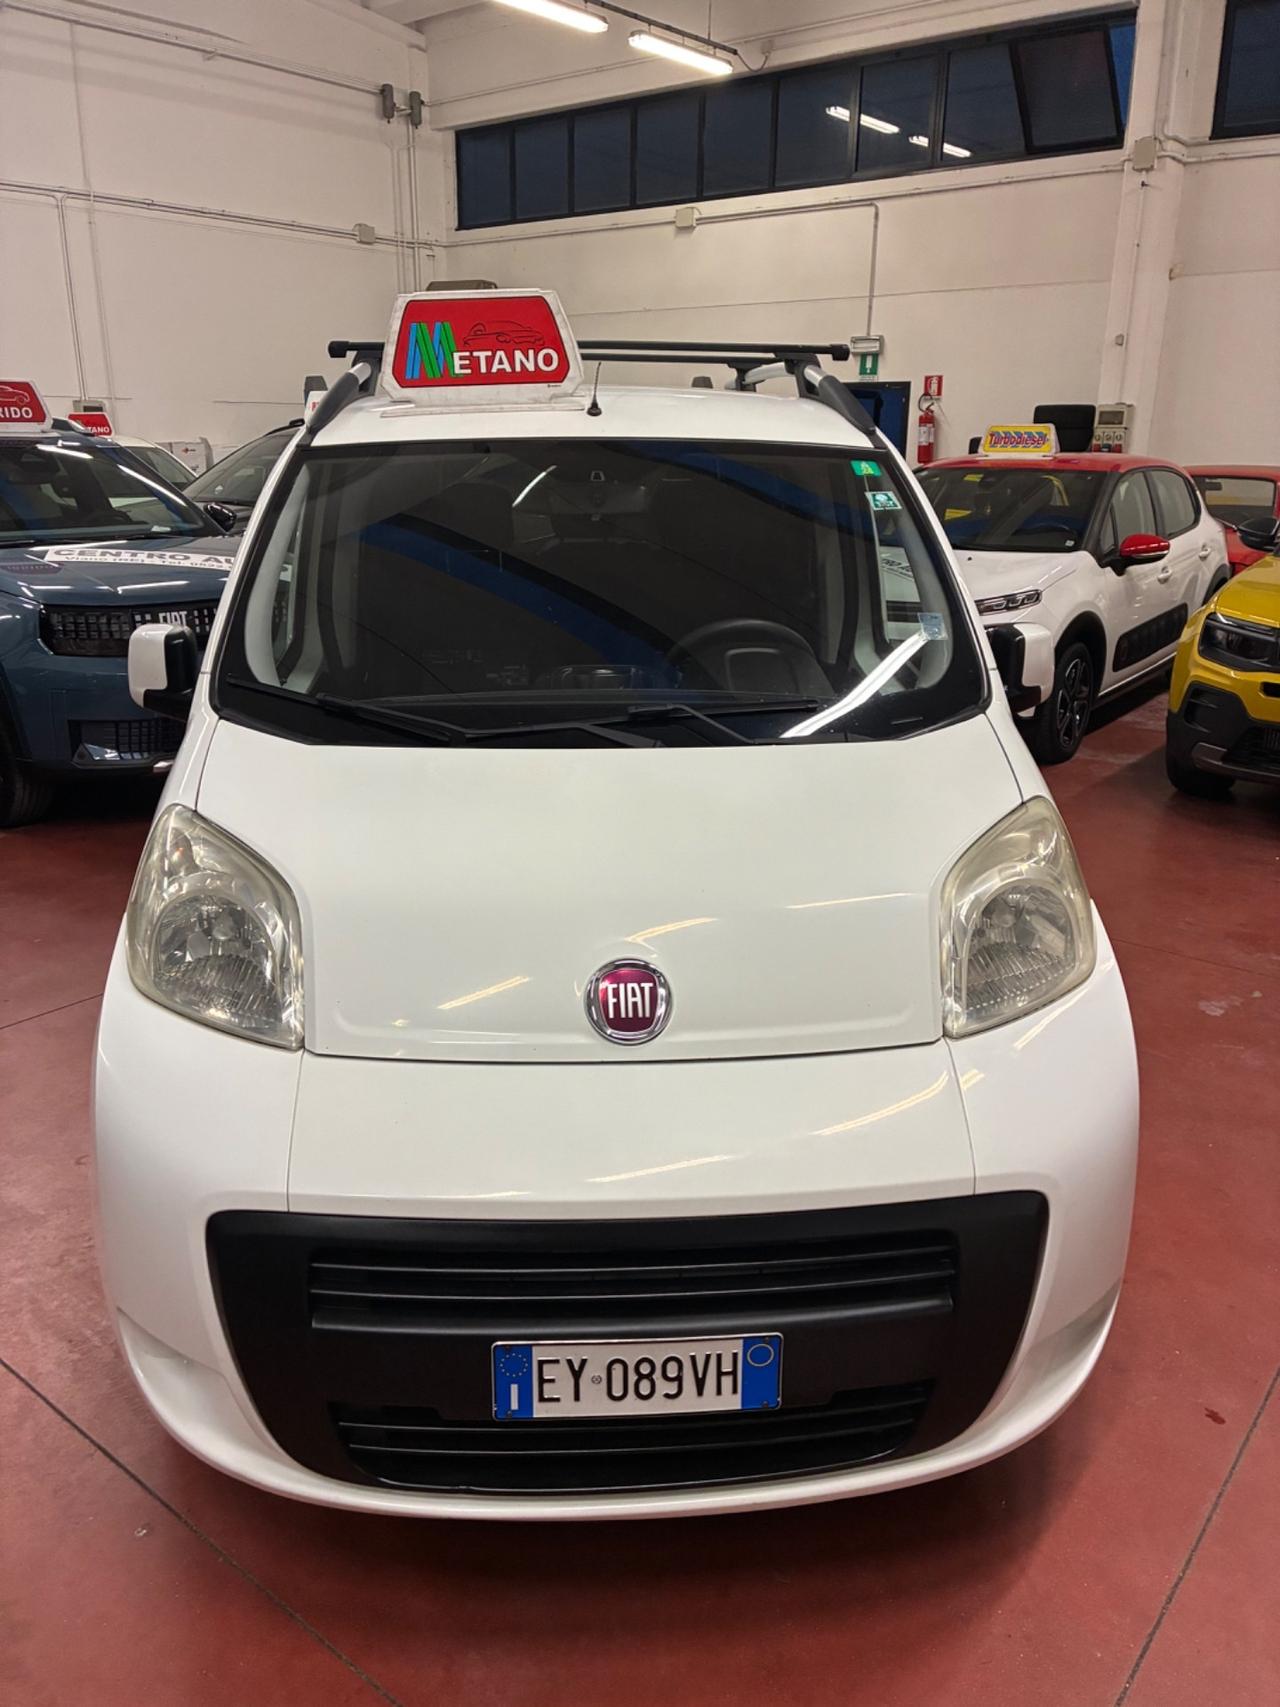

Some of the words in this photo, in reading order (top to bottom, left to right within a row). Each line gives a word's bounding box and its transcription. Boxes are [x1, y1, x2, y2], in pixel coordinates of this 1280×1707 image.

[405, 321, 559, 380] METANO
[988, 431, 1048, 447] Turbodiesel
[54, 549, 190, 560] CENTRO
[606, 982, 654, 1019] FIAT
[536, 1356, 589, 1403] EY
[606, 1349, 739, 1402] 089VH
